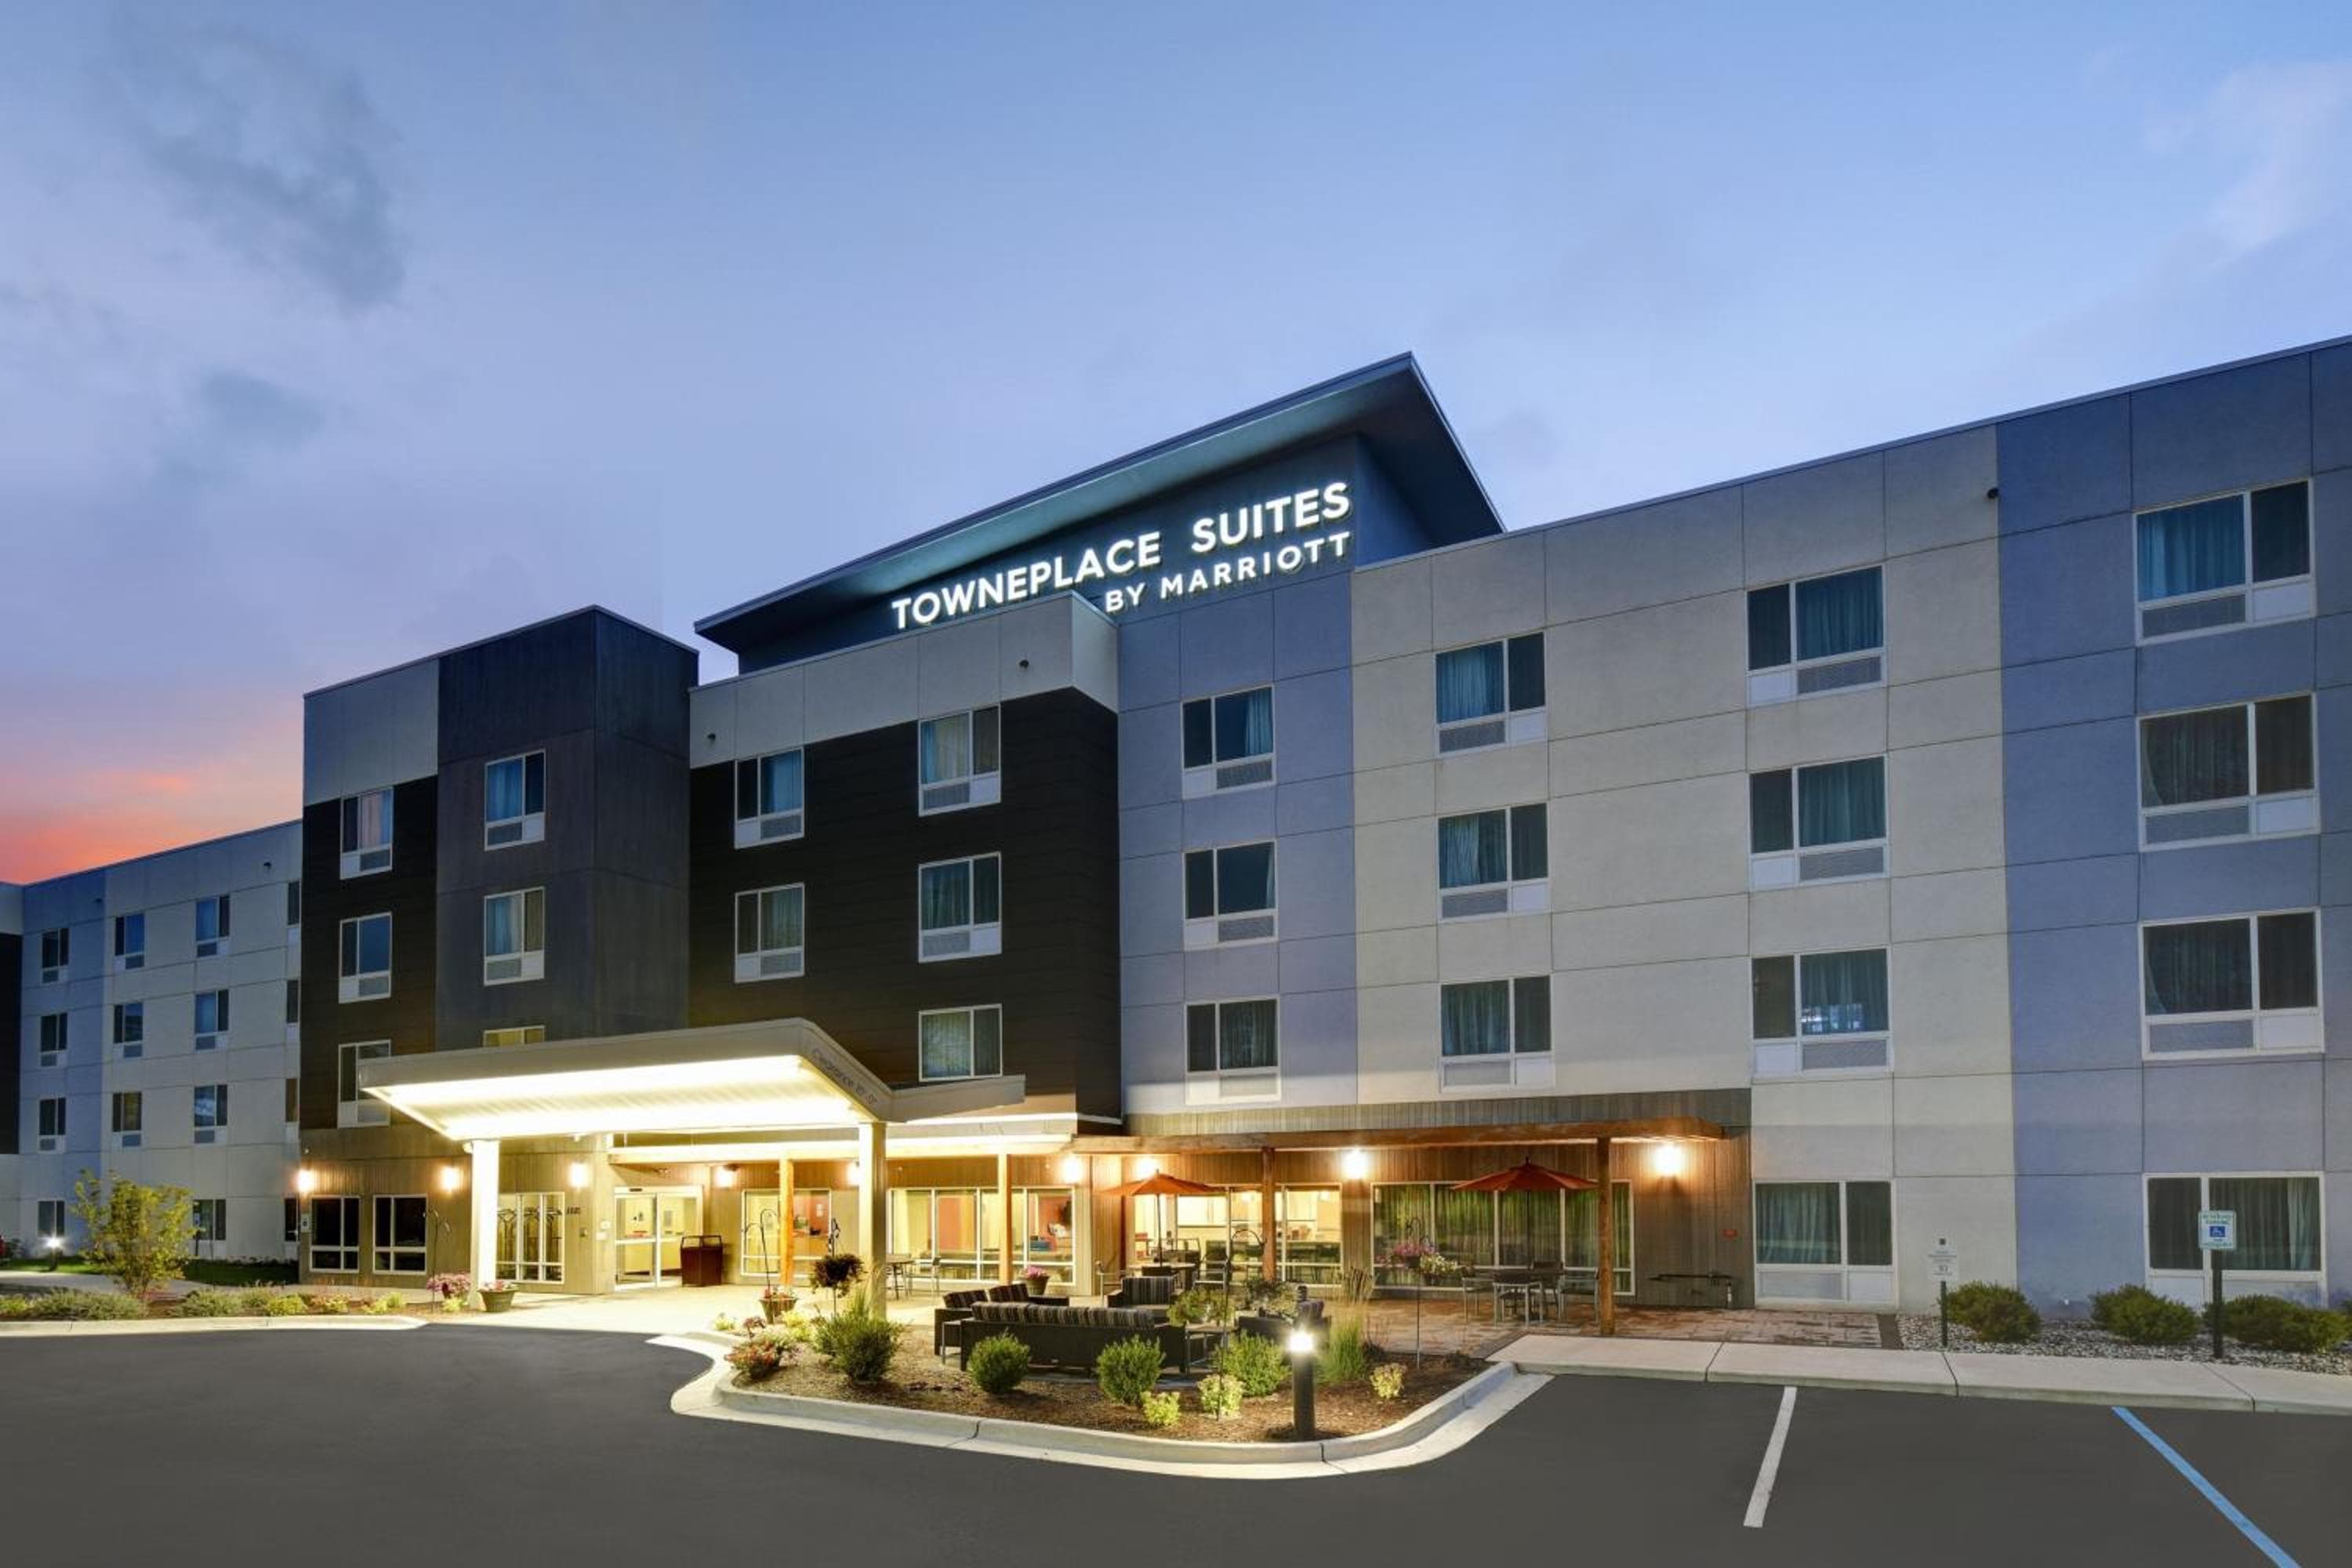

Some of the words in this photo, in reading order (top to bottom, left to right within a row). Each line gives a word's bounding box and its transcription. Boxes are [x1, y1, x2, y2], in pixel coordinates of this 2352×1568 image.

[891, 532, 1162, 629] TOWNEPLACE
[1191, 482, 1350, 553] SUITES
[1105, 583, 1145, 613] BY
[1160, 531, 1351, 599] MARRIOTT
